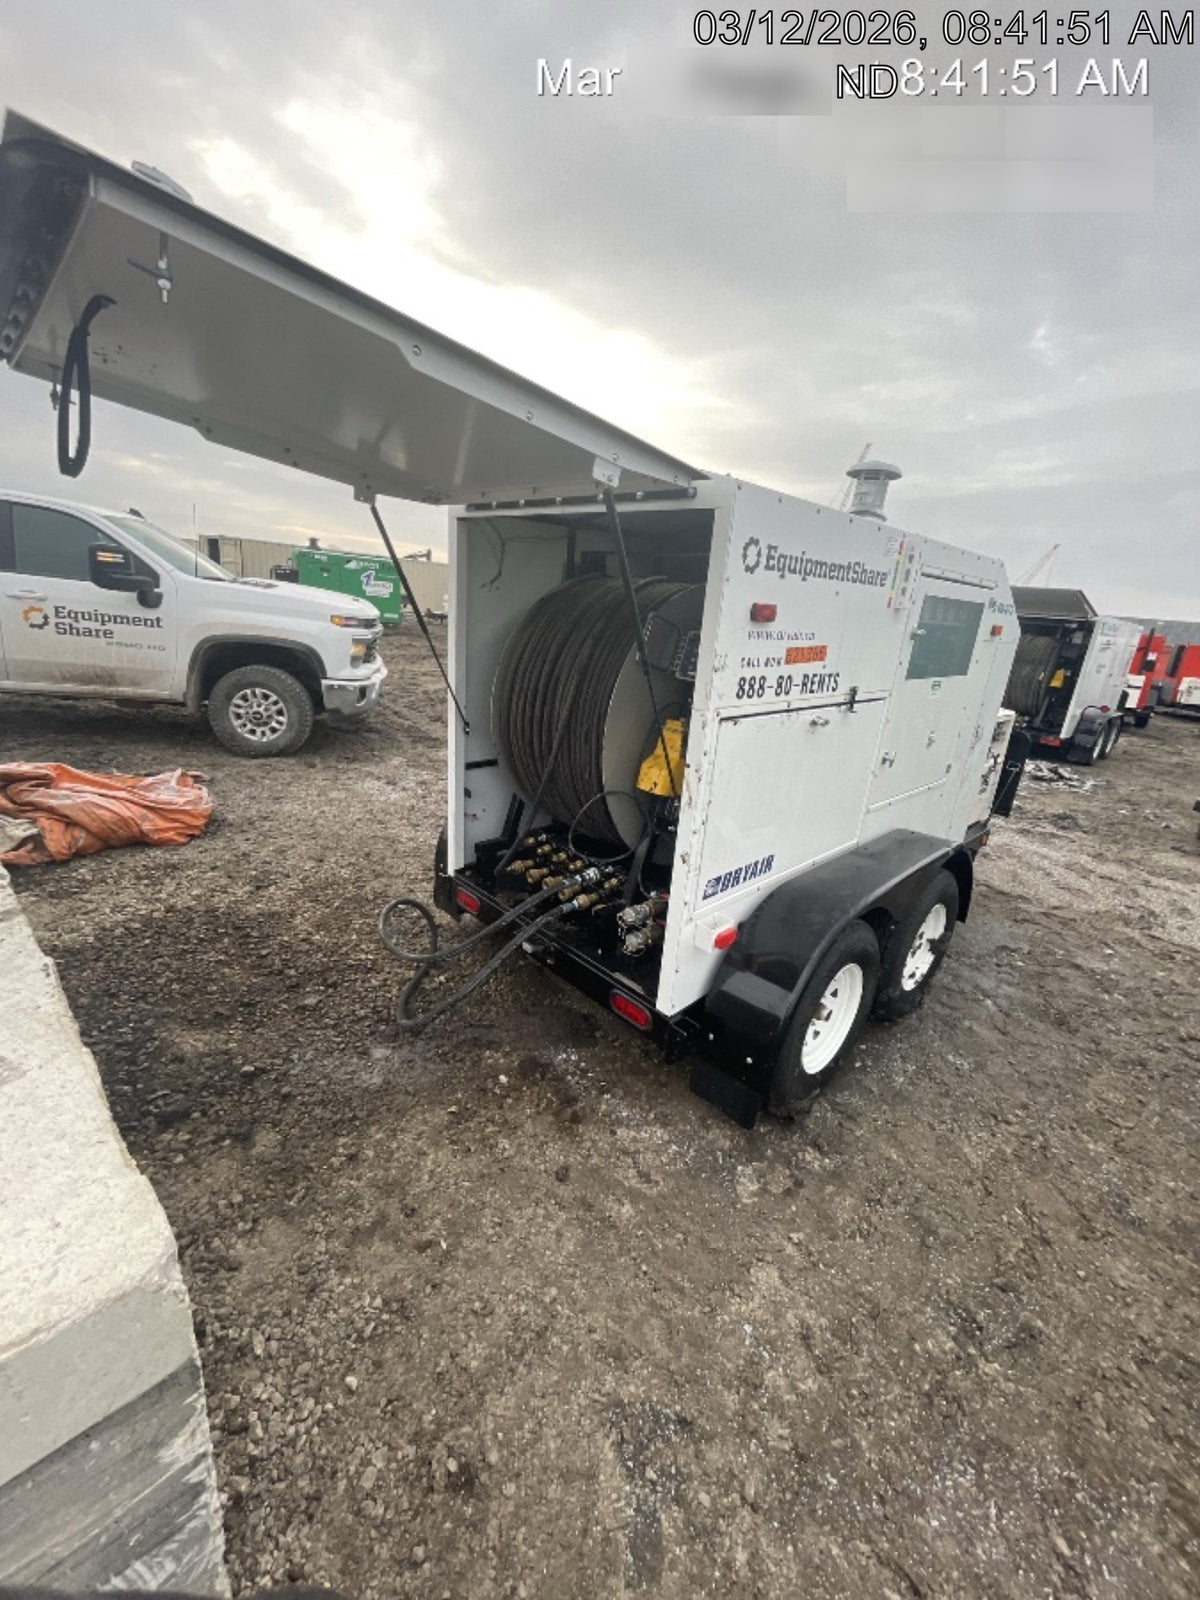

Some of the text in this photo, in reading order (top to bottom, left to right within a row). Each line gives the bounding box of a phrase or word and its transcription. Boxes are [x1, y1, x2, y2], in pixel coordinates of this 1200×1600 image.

[764, 543, 888, 588] EquipmentShare
[53, 605, 164, 628] Equipment
[54, 622, 115, 639] Share
[735, 672, 840, 699] 888-80-RENTS
[720, 854, 775, 893] DRYAIR
